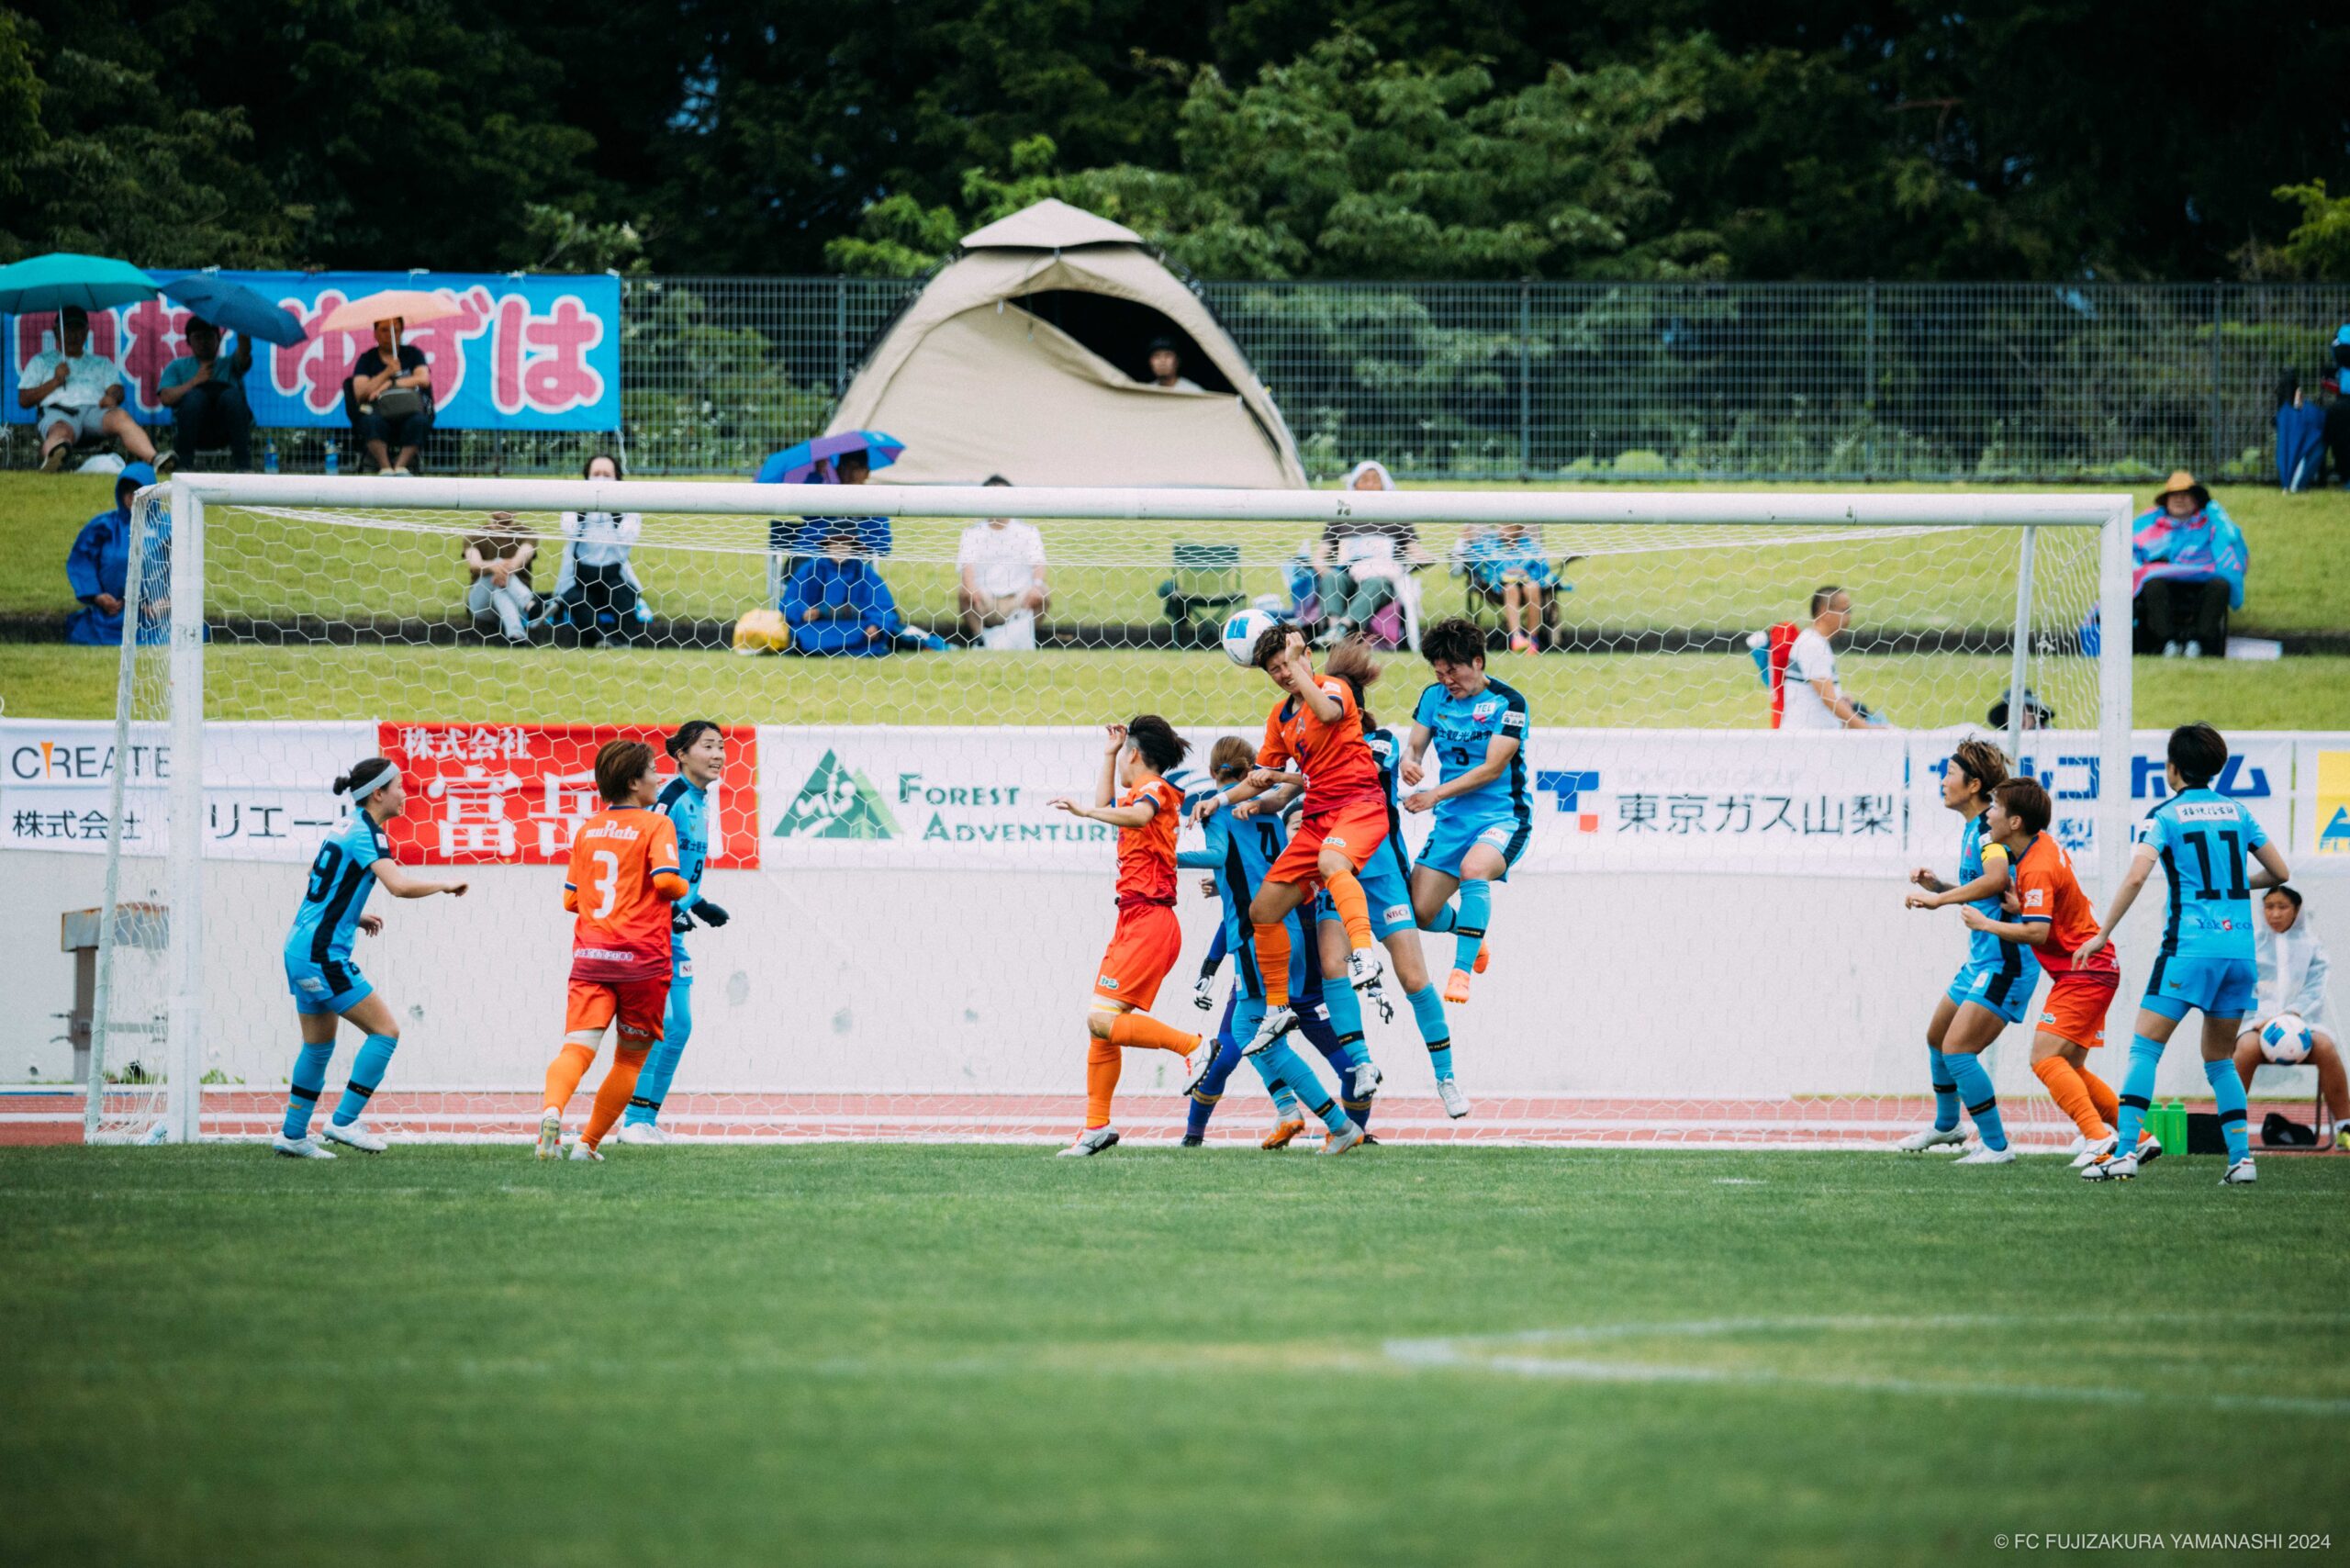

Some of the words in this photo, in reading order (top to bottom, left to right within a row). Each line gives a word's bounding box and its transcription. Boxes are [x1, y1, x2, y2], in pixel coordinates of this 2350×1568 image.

[403, 726, 532, 761] 株式会社
[1451, 745, 1470, 766] 3
[899, 772, 1021, 806] FOREST
[1617, 793, 1894, 835] 東京ガス山梨
[690, 858, 704, 884] 9
[2184, 830, 2252, 901] 11
[592, 850, 619, 919] 3
